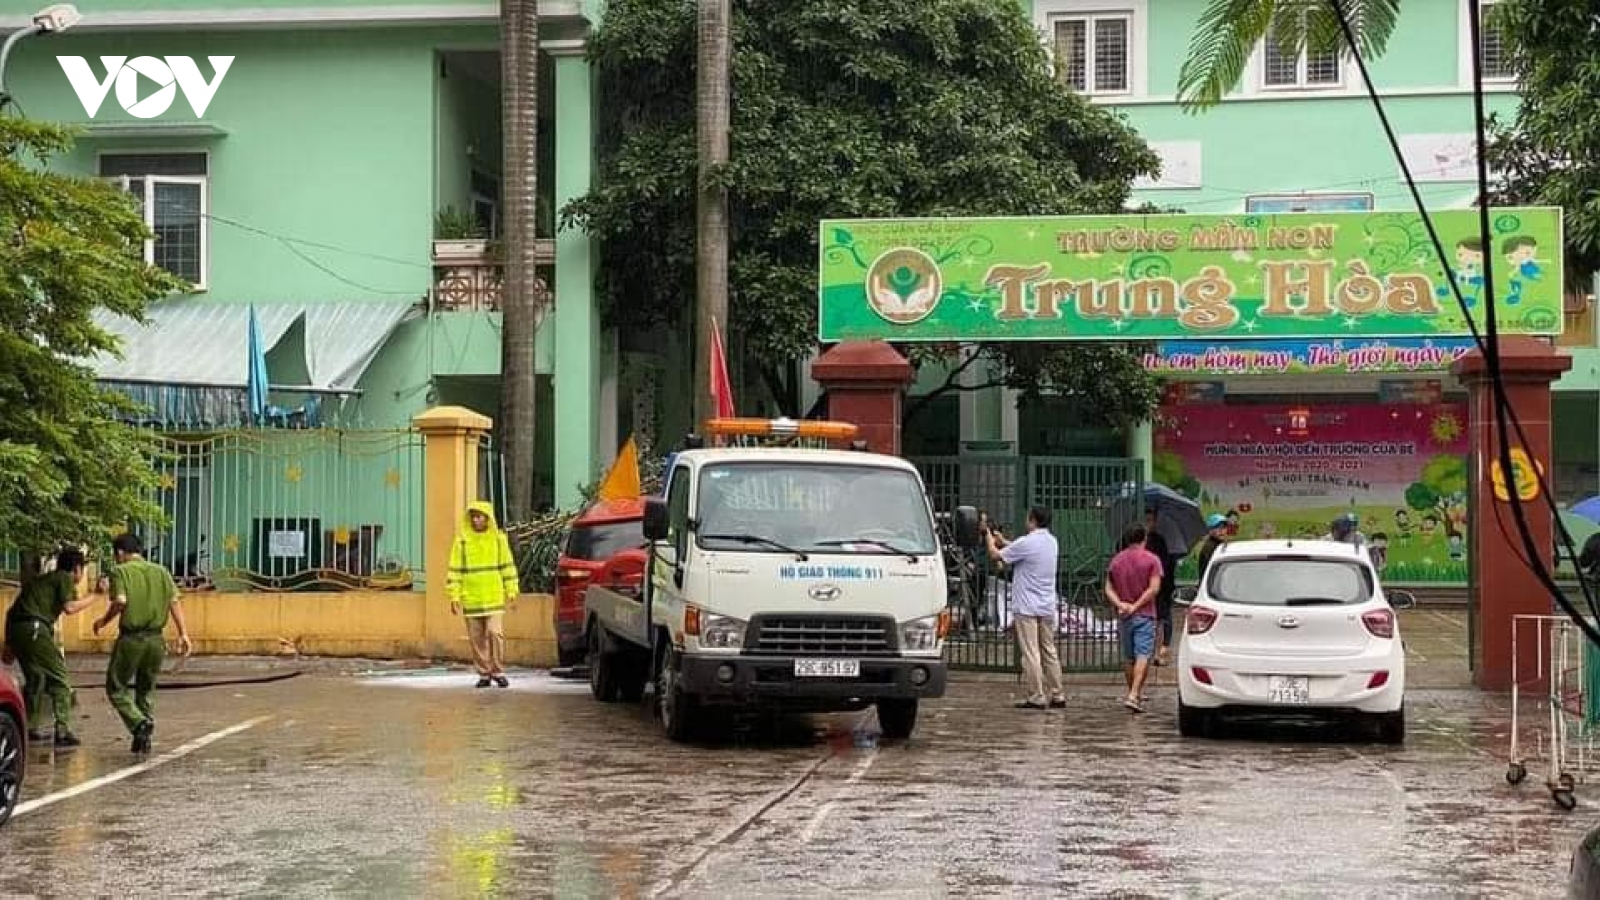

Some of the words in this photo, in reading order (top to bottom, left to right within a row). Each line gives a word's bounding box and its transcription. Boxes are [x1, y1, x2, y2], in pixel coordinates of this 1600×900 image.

[1056, 226, 1180, 253] TRƯỜNG
[1188, 219, 1258, 250] MẦM
[1267, 225, 1334, 250] NON
[986, 262, 1239, 329] Trung
[1258, 258, 1442, 319] Hòa
[1169, 352, 1197, 369] em
[1253, 351, 1292, 372] nay
[798, 565, 824, 578] GIAO
[865, 567, 883, 579] 911
